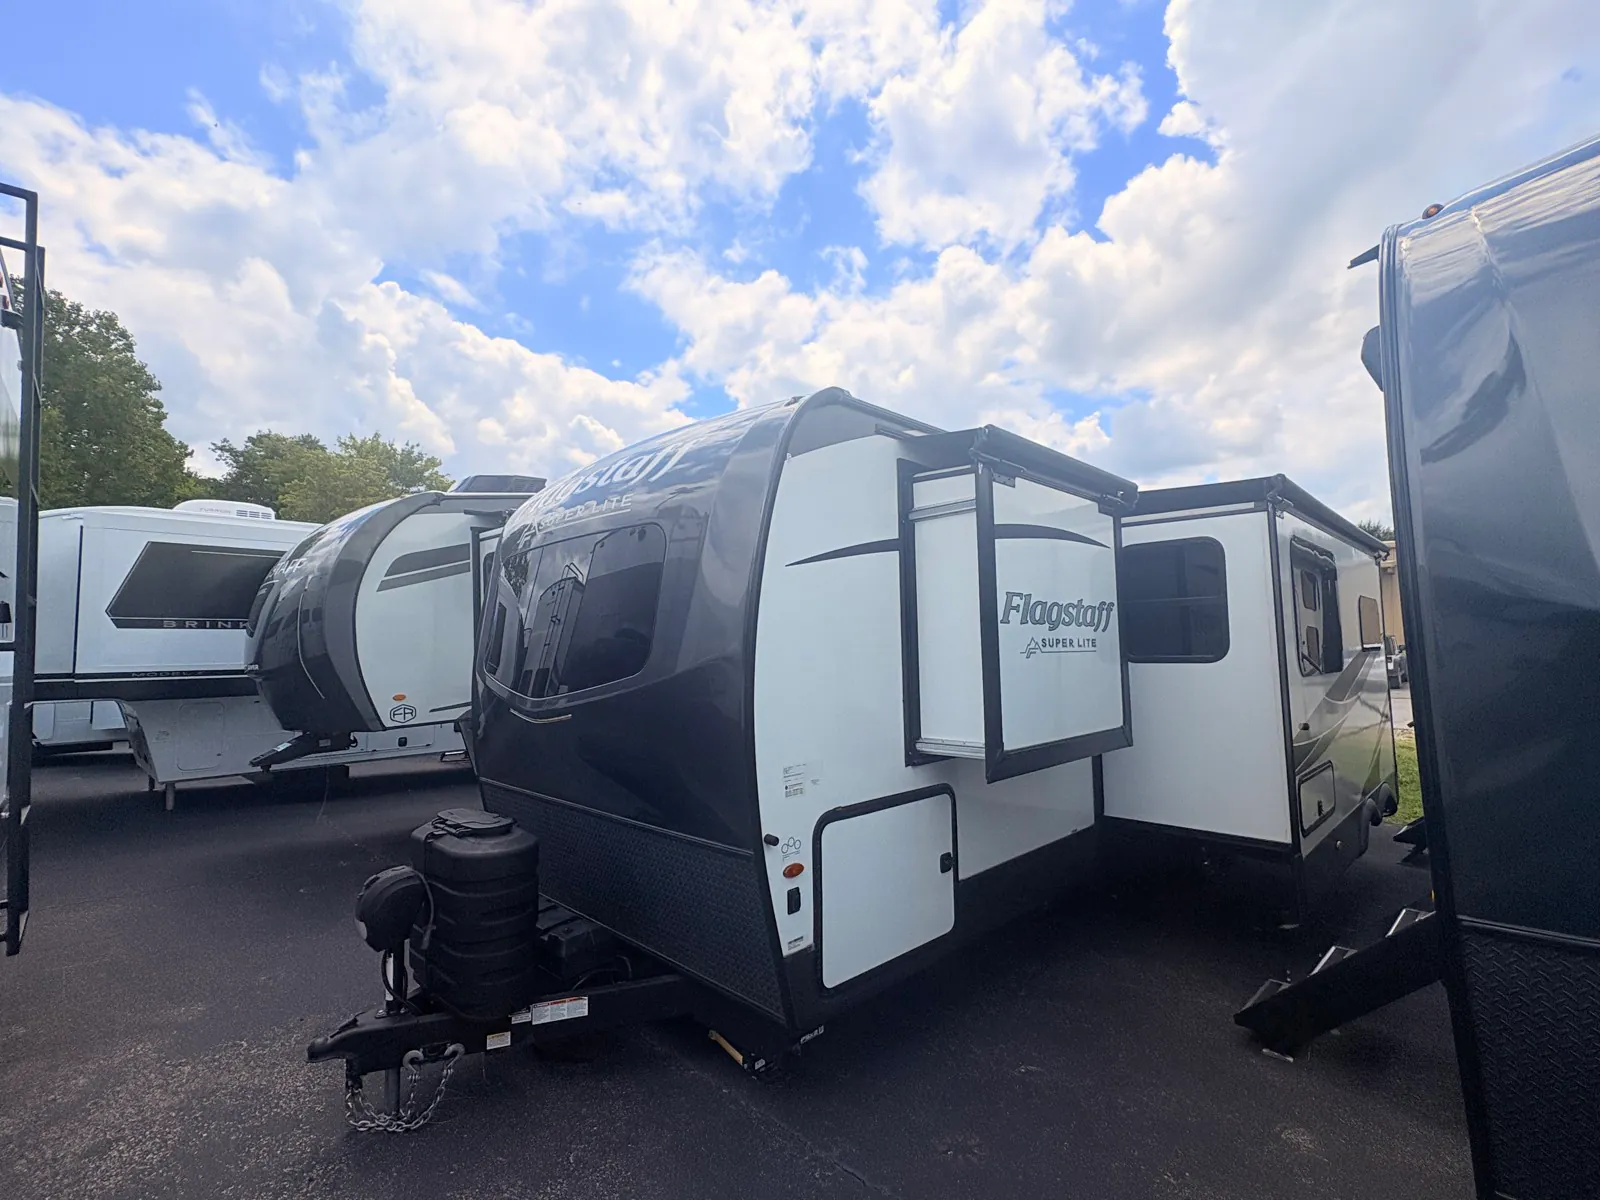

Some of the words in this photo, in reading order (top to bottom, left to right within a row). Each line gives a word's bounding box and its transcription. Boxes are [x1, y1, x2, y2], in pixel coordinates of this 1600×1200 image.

[592, 493, 634, 514] LITE
[1000, 591, 1115, 632] Flagstaff
[1041, 638, 1074, 648] SUPER
[1077, 638, 1097, 648] LITE
